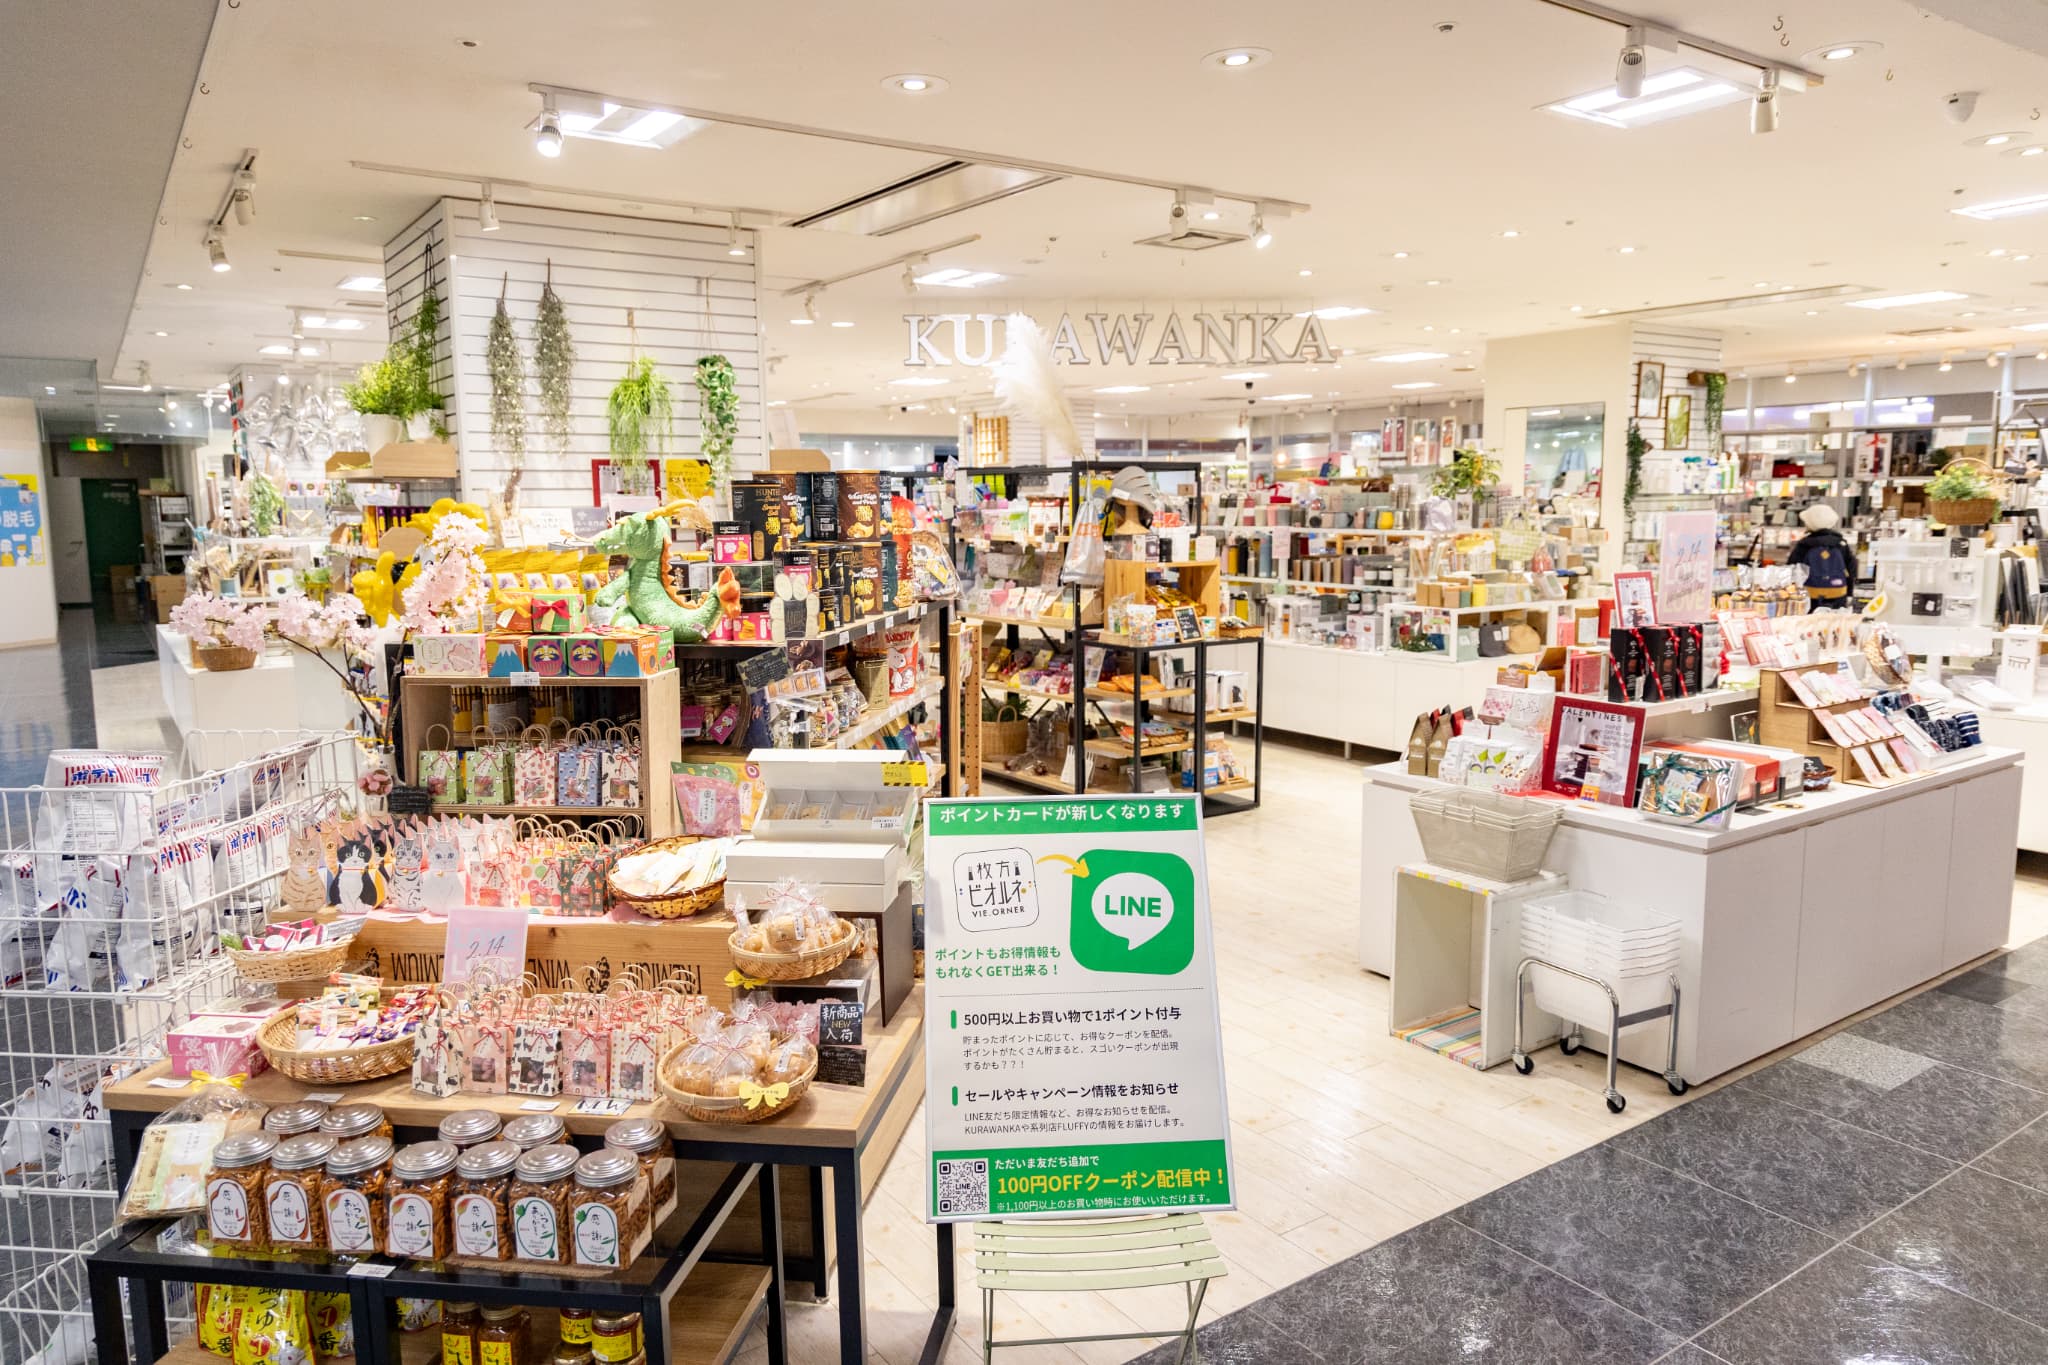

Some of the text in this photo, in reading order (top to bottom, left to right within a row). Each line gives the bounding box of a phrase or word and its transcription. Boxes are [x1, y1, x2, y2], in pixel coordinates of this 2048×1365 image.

[903, 313, 1338, 367] KUAWANKA
[0, 510, 35, 528] 脱毛
[1562, 707, 1622, 722] VALENTINES
[939, 803, 1185, 824] ポイントカードが新しくなります
[977, 861, 1011, 880] 枚方
[968, 880, 1022, 908] ビオルネ
[1104, 894, 1162, 918] LINE
[466, 935, 506, 961] 2.14
[935, 946, 1061, 962] ポイントもお得情報も
[935, 963, 1059, 979] もれなくGET出来る！
[822, 1005, 860, 1020] 新商品
[964, 1006, 1182, 1027] 500円以上お買い物で1ポイント付与
[831, 1020, 852, 1029] NEW
[826, 1027, 854, 1043] 入荷
[963, 1029, 1173, 1046] 貯まったポイントに応じて、お得なクーポンを配信。
[965, 1082, 1179, 1103] セールやキャンペーン情報をお知らせ
[964, 1105, 1172, 1122] LINE友だち限定情報など、お得なお知らせを配信。
[964, 1119, 1184, 1135] KURAWANKAや系列店FLUFFYの情報をお届けします。
[995, 1155, 1100, 1170] ただいま友だち追加で
[998, 1168, 1224, 1195] 100円OFFクーポン配信中！
